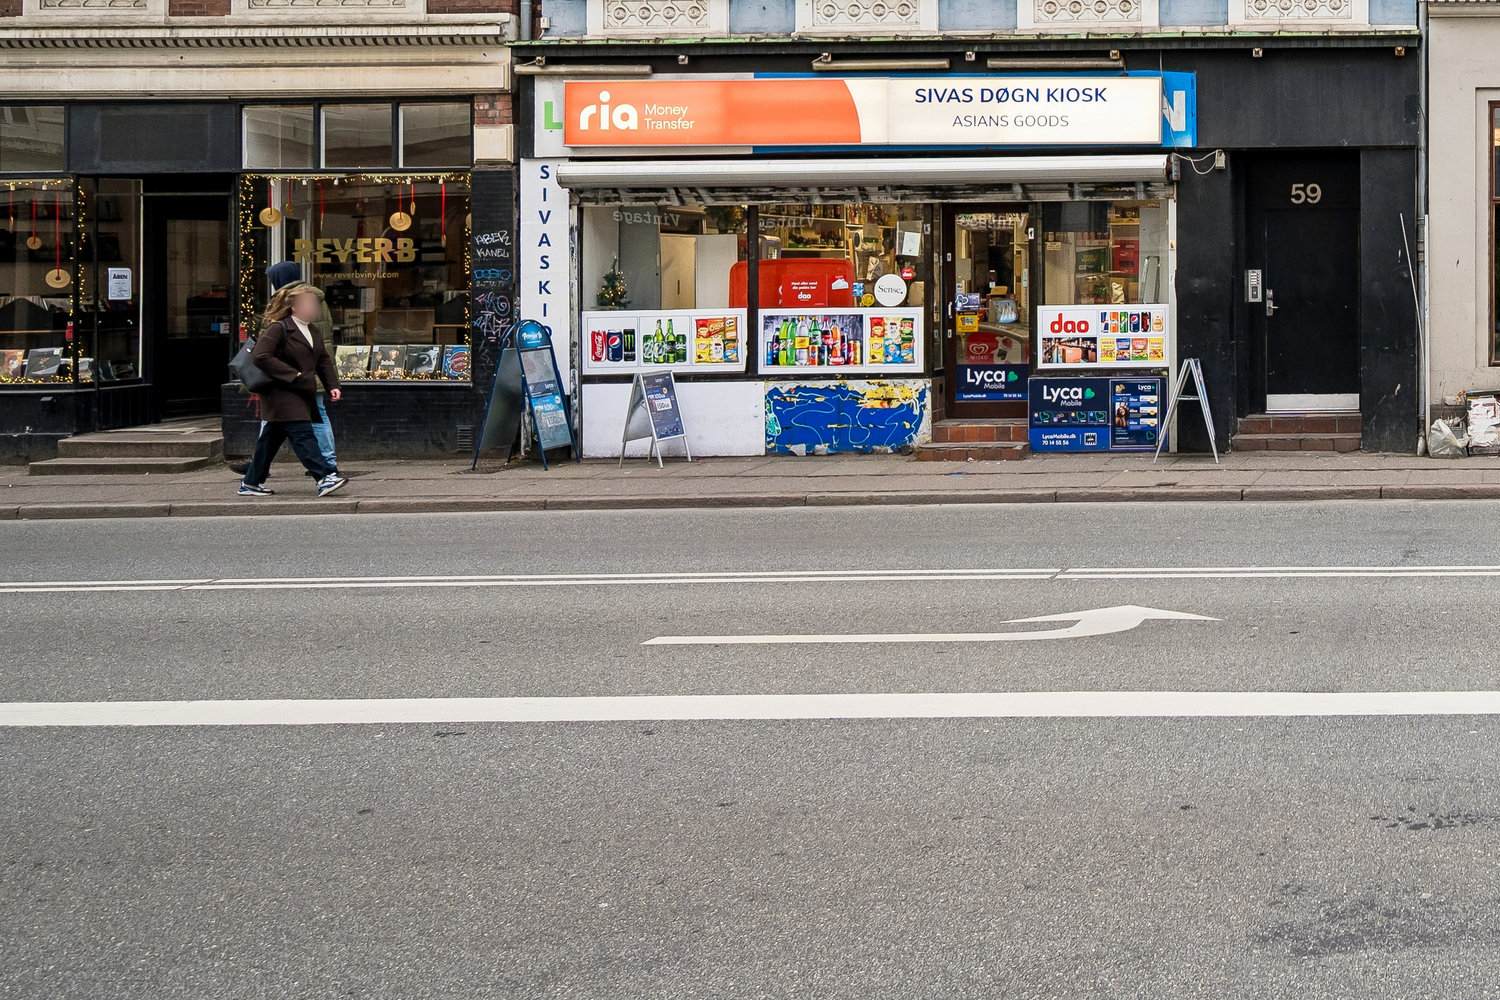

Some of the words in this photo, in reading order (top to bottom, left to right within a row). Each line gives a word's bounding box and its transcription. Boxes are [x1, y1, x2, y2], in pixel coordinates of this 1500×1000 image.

[914, 88, 974, 104] SIVAS
[980, 86, 1040, 104] DØGN
[1046, 86, 1108, 102] KIOSK
[579, 90, 638, 130] ria
[644, 103, 688, 118] Money
[644, 118, 695, 130] Transfer
[952, 115, 1009, 128] ASIANS
[1014, 115, 1070, 128] GOODS
[1290, 184, 1322, 204] 59
[292, 238, 419, 264] REVERB
[313, 270, 400, 280] www.reverbvinyl.com
[1050, 313, 1089, 334] dao
[966, 368, 1006, 385] Lyca
[1043, 385, 1082, 400] Lyca
